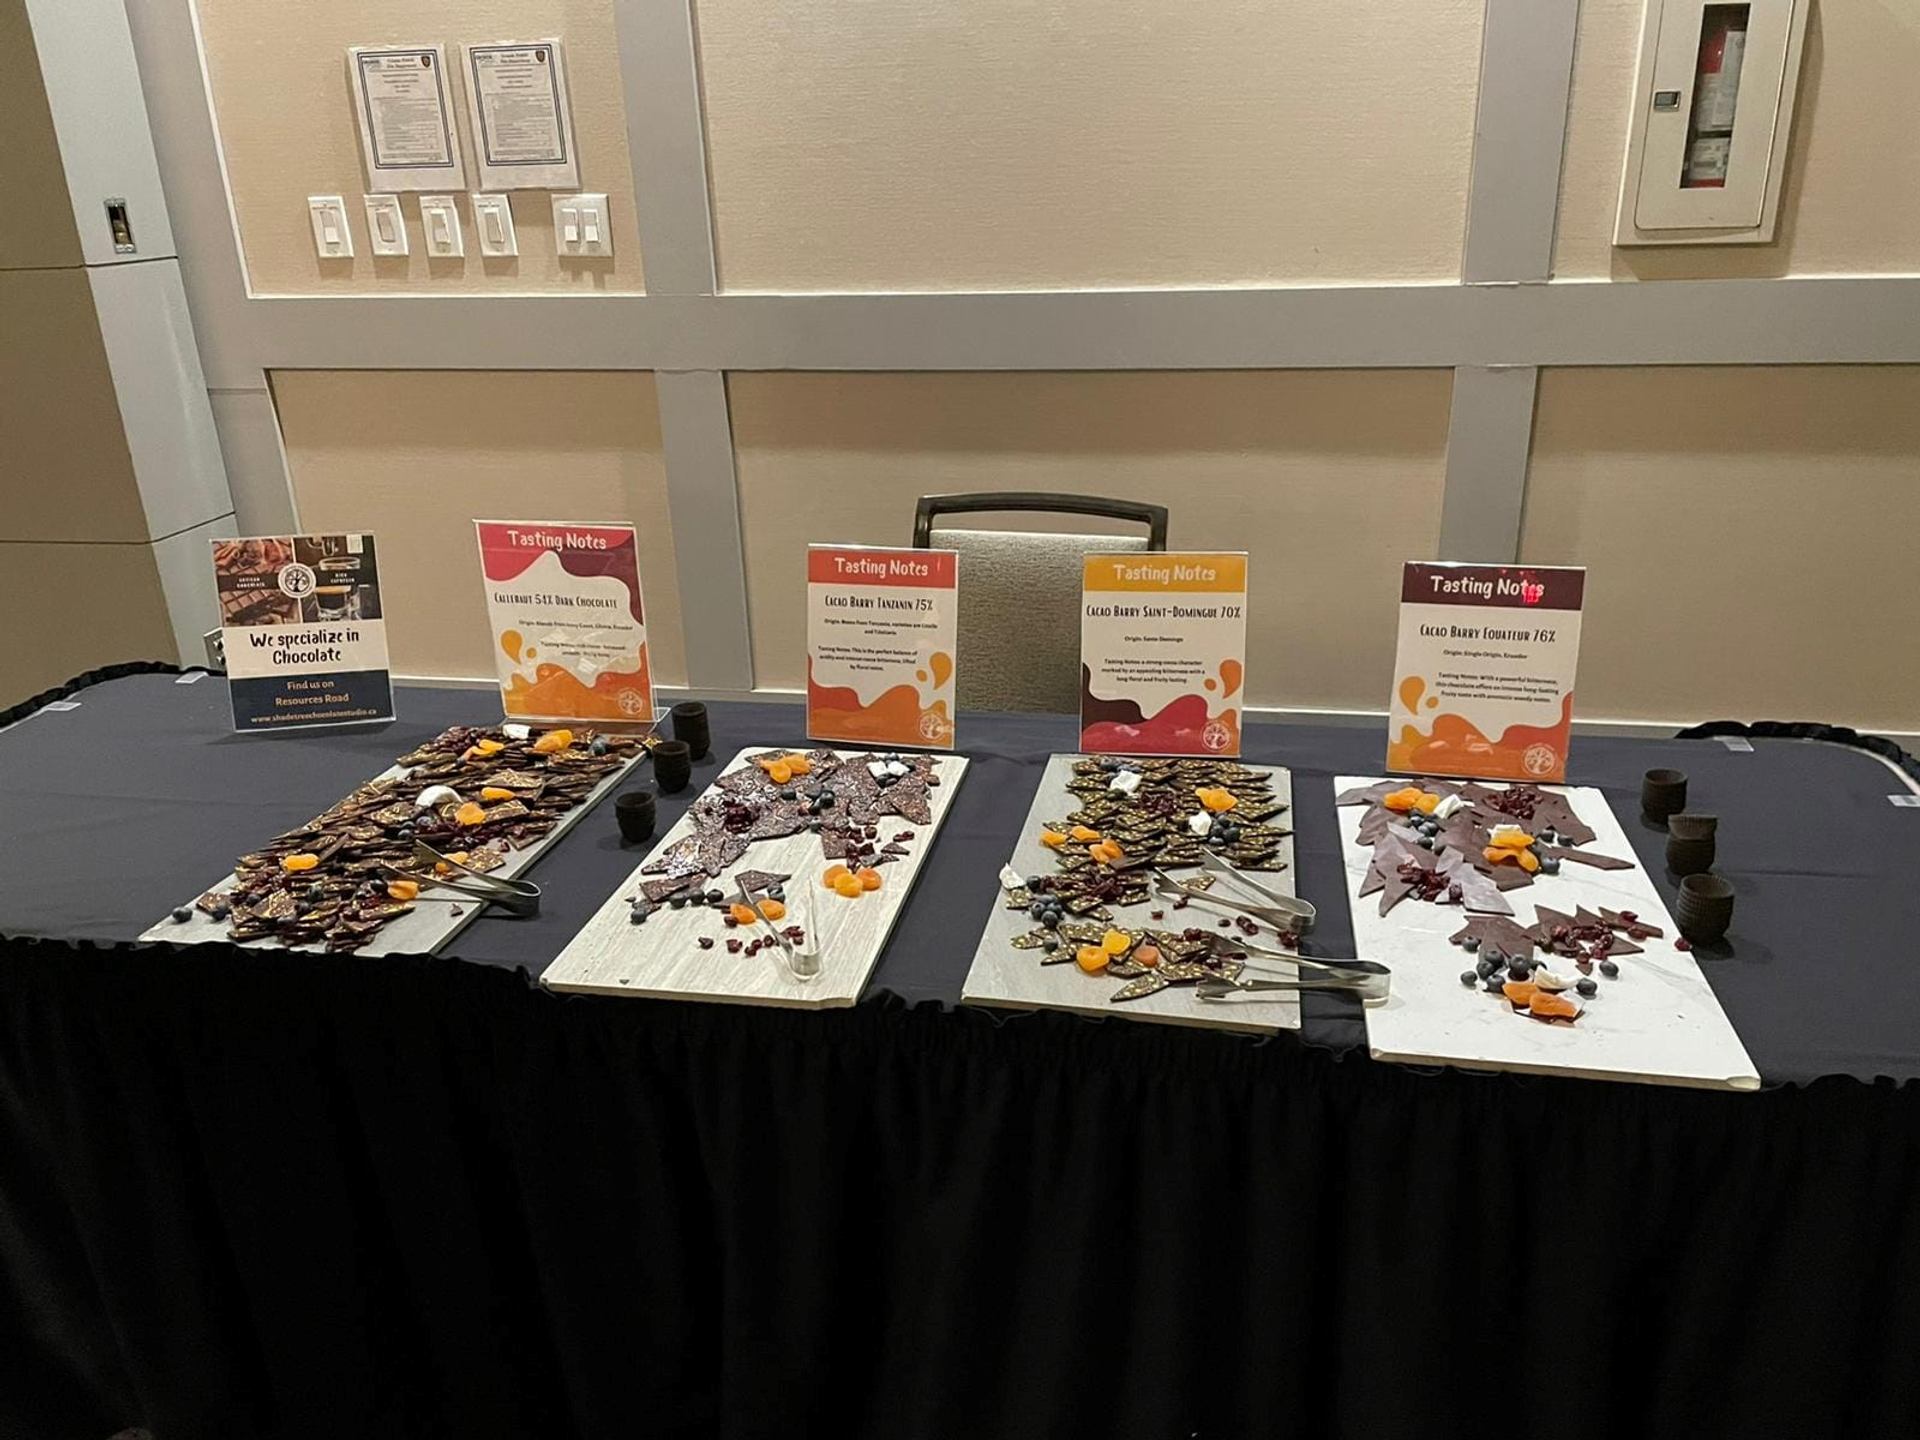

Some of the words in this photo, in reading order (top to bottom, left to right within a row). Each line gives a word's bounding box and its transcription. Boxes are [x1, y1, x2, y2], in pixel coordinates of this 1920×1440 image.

[507, 530, 562, 552] Tasting
[566, 533, 606, 550] Notes
[834, 557, 886, 579] Tasting
[890, 560, 928, 576] Notes
[1113, 564, 1170, 584] Tasting
[1174, 564, 1216, 580] Notes
[1430, 576, 1493, 599] Tasting
[1496, 578, 1544, 597] Notes
[915, 599, 933, 611] 75%
[1220, 606, 1240, 618] 70%
[250, 632, 272, 647] We
[278, 630, 342, 650] specialize
[346, 628, 360, 642] in
[1533, 630, 1556, 643] 76%
[272, 648, 342, 665] Chocolate
[287, 680, 308, 690] Find
[322, 680, 334, 688] on
[275, 695, 323, 706] Resources
[325, 693, 350, 704] Road
